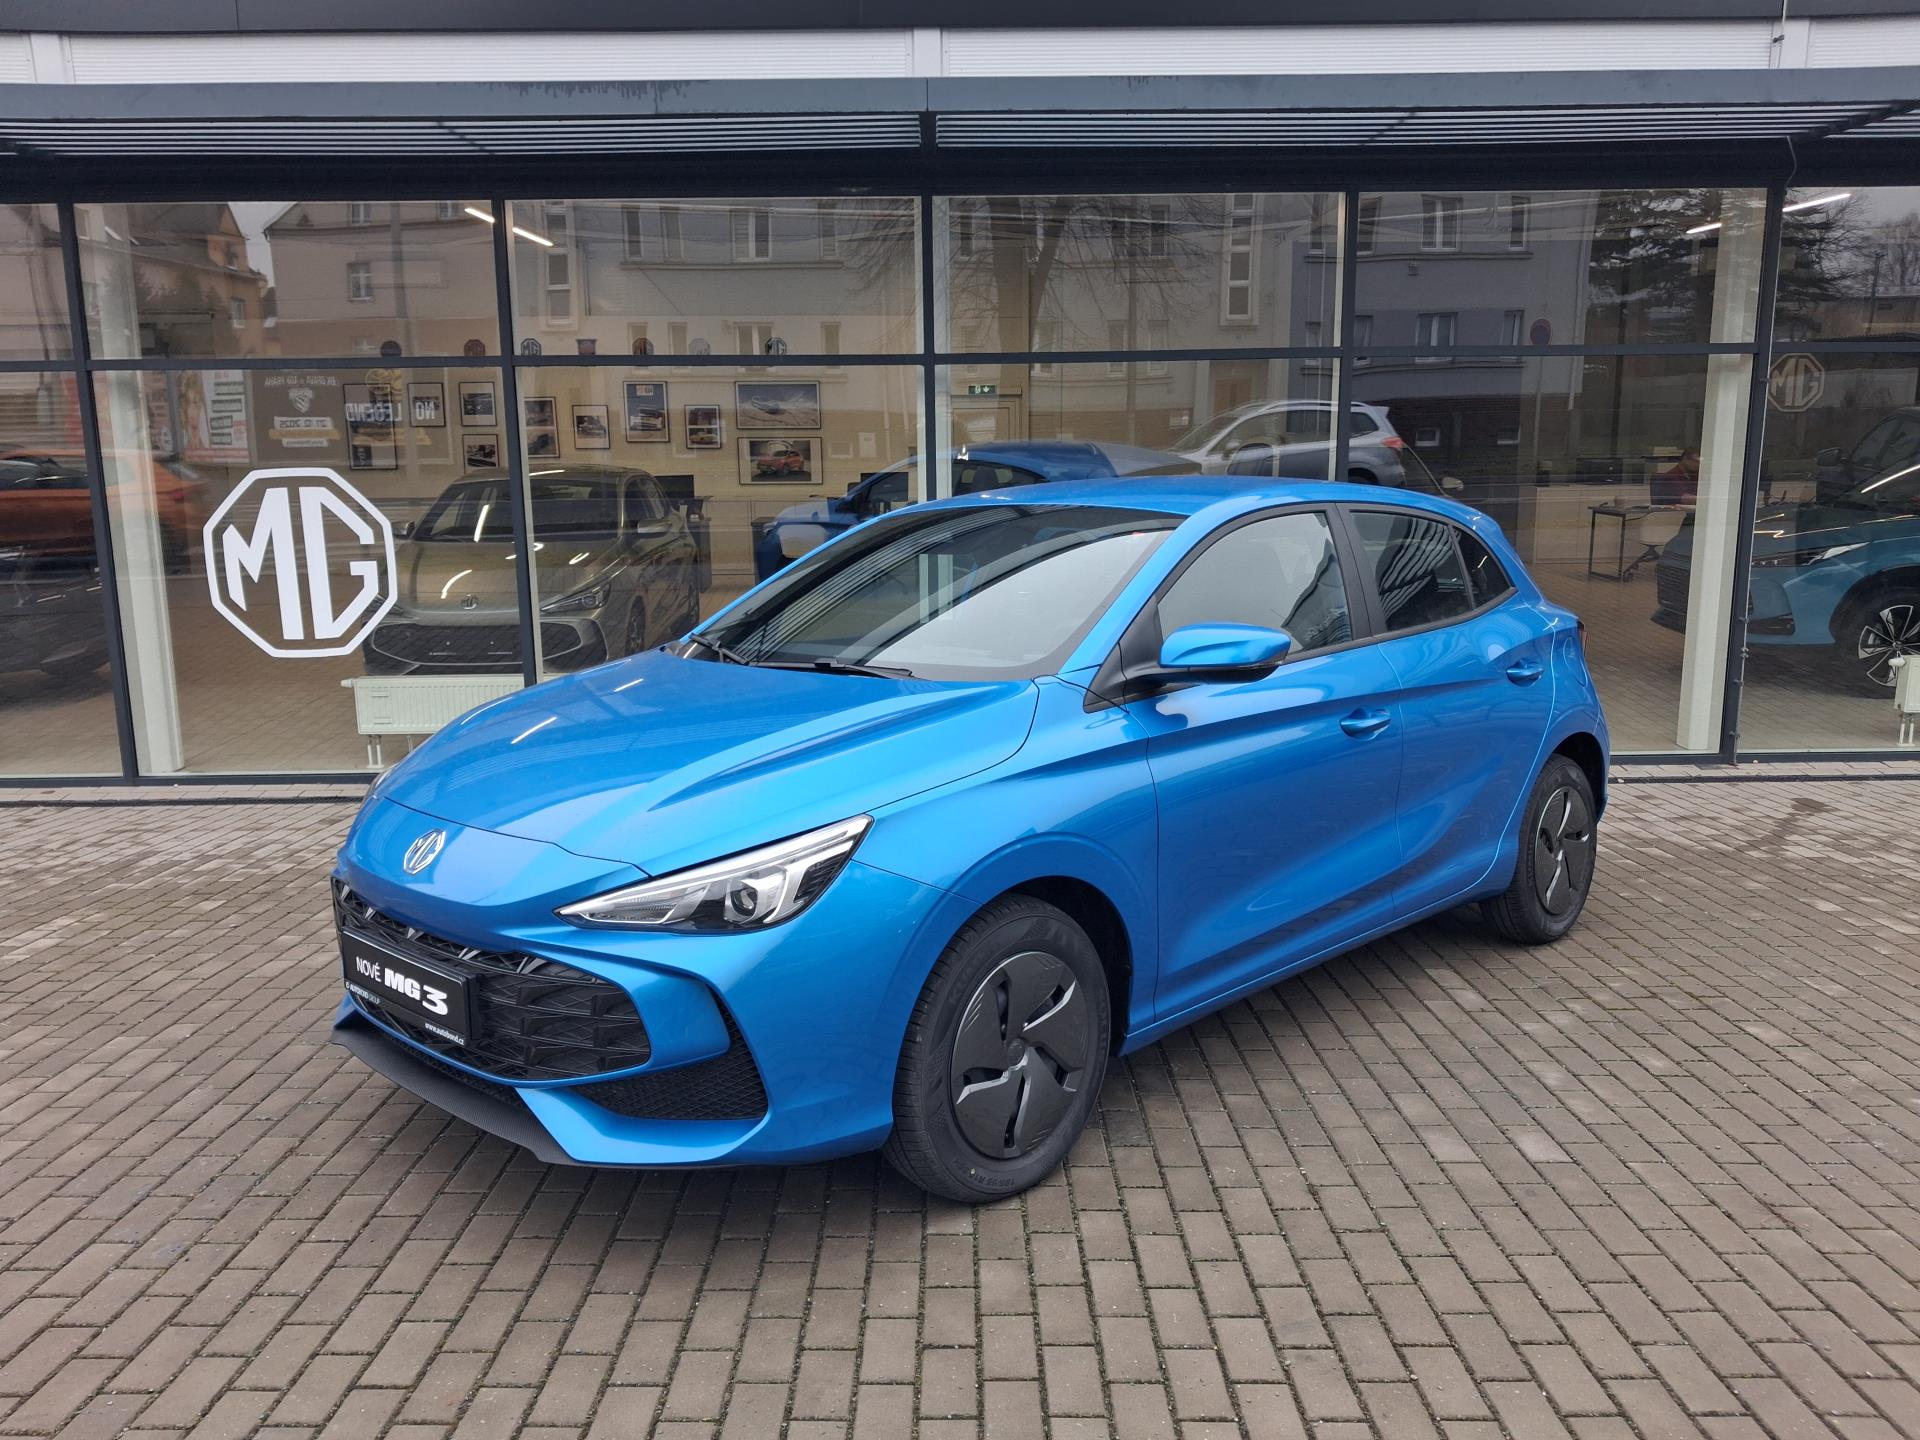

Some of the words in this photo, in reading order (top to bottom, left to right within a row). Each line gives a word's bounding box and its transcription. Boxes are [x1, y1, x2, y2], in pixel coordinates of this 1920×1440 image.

[1771, 358, 1819, 407] MG
[222, 486, 379, 640] MG
[407, 832, 442, 870] MG
[355, 956, 382, 982] NOVÉ
